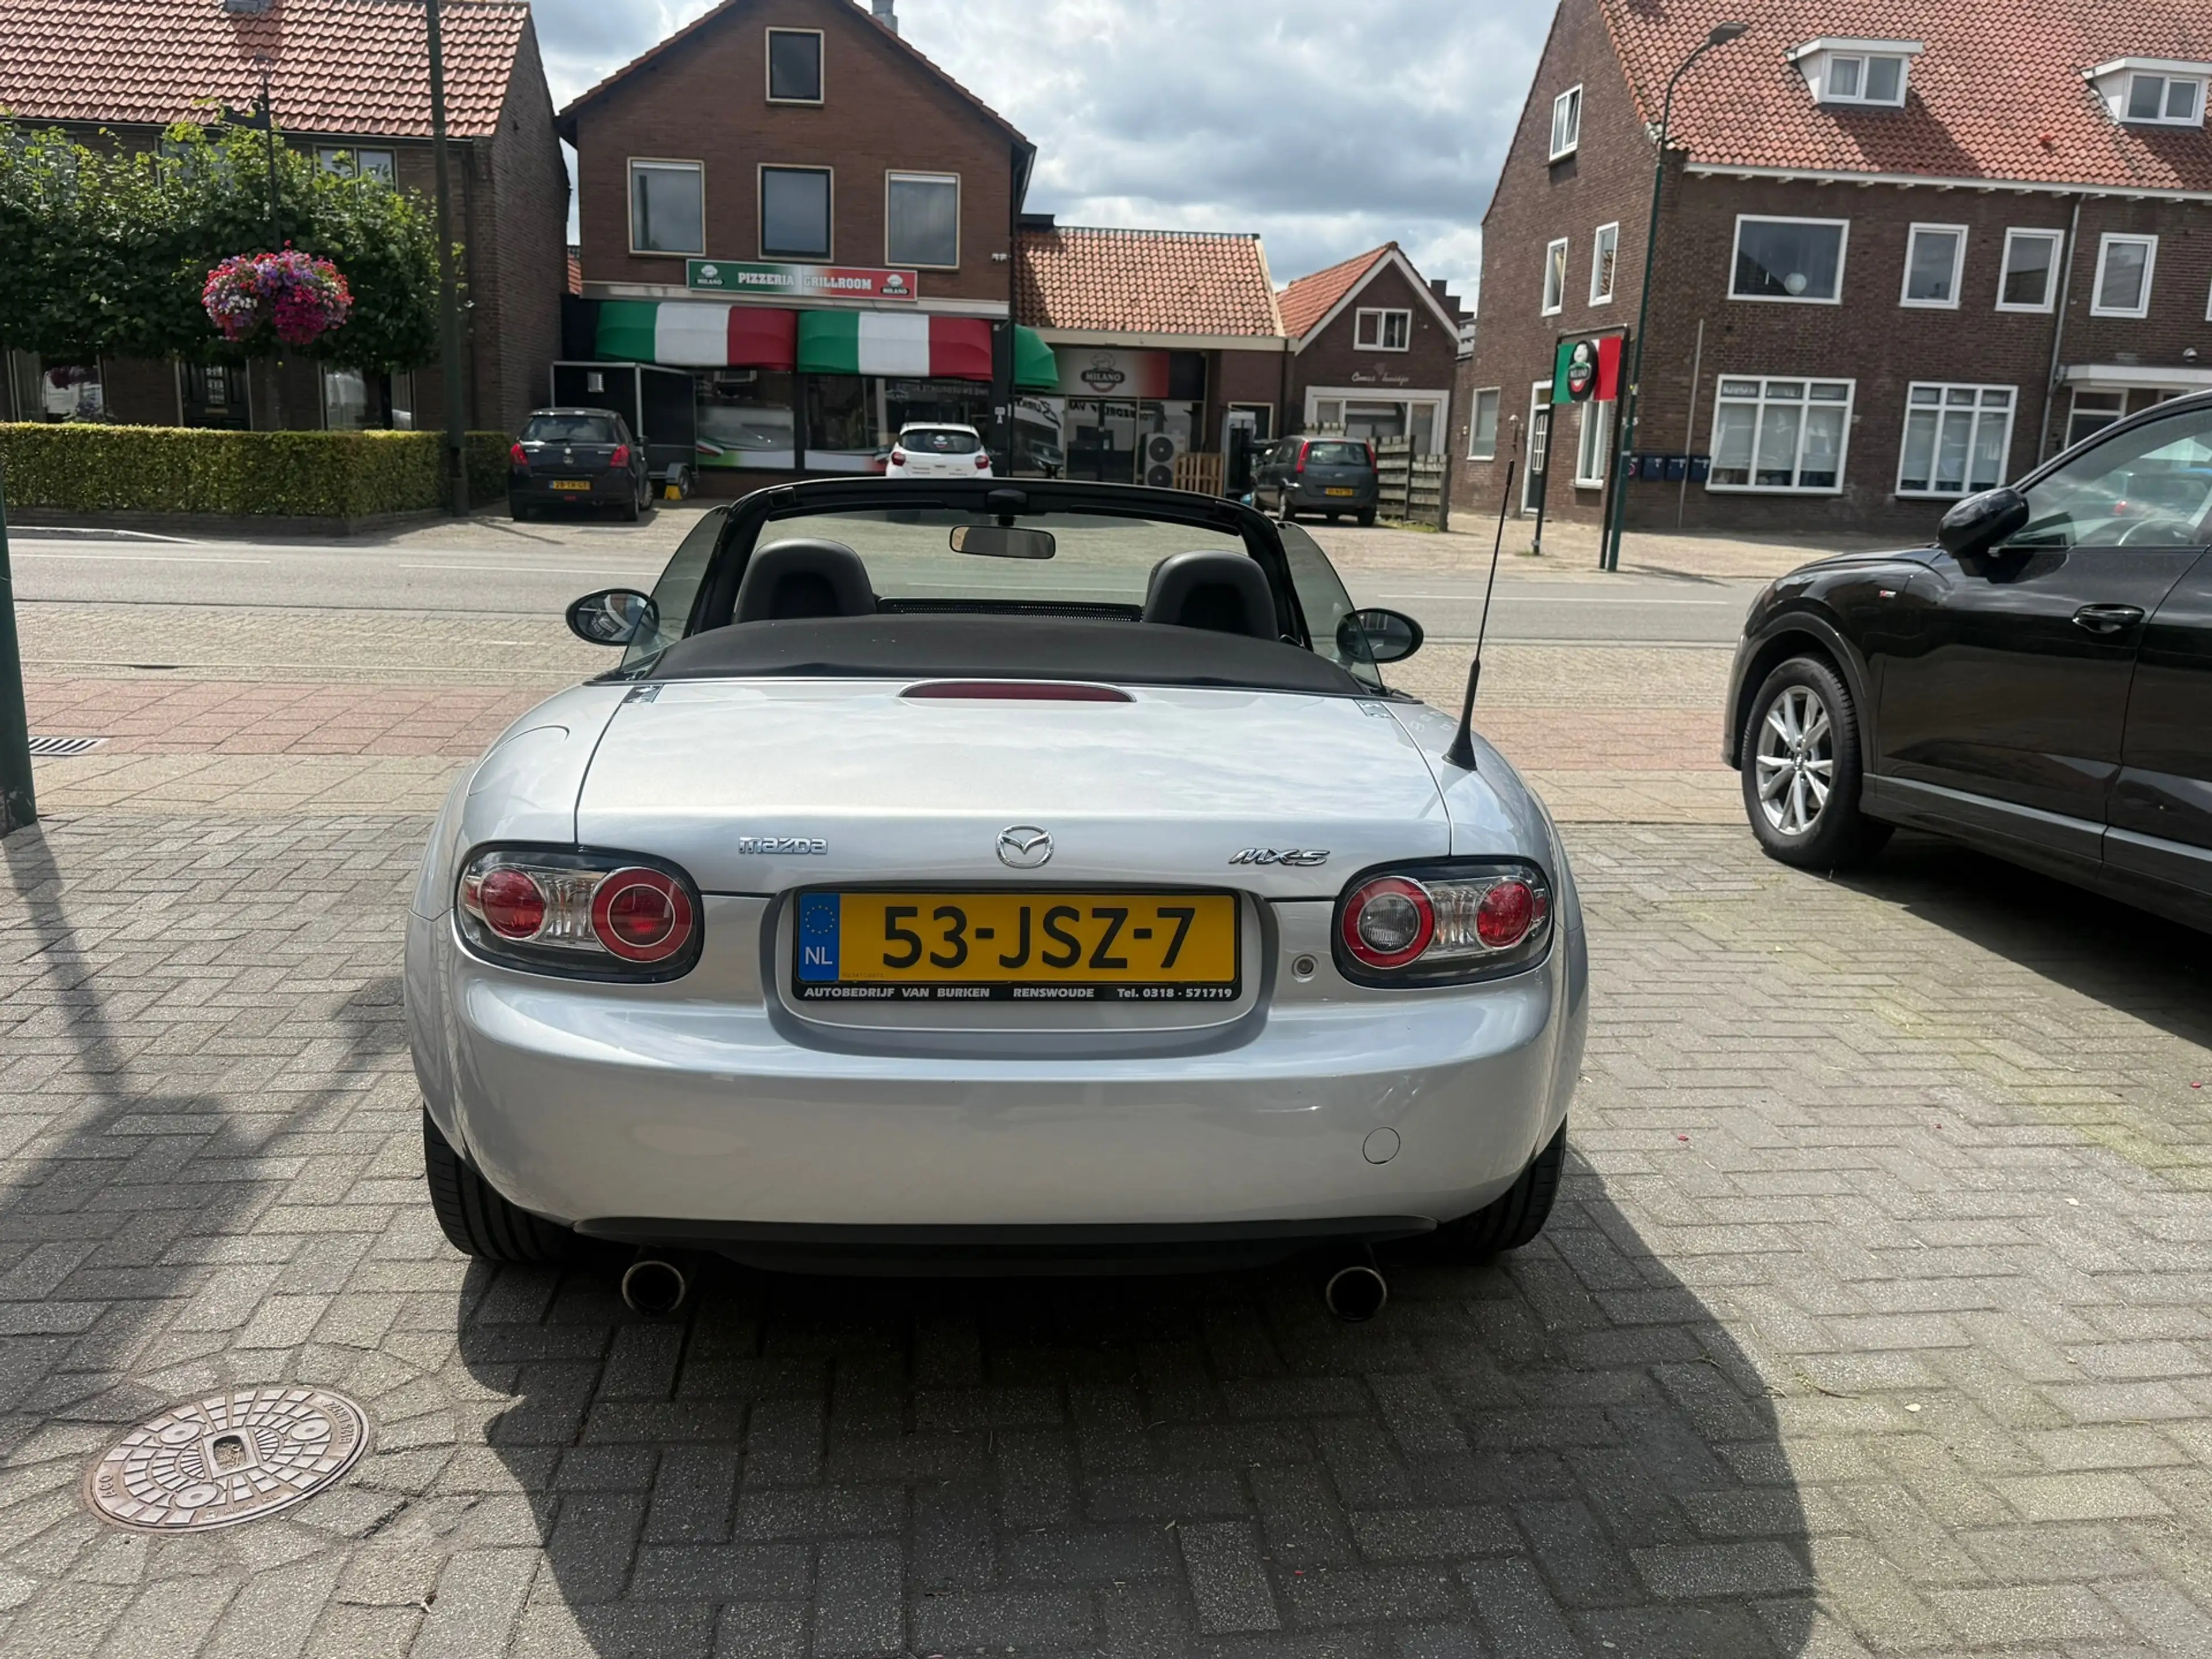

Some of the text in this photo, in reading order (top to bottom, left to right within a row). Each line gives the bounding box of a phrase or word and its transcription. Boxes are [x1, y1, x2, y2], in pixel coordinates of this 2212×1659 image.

[738, 272, 872, 290] PIZZERIA GRILLROOM
[1085, 372, 1122, 381] MILANO
[1228, 847, 1330, 866] MX-5
[883, 906, 1195, 969] 53-JSZ-7
[805, 946, 833, 965] NL
[804, 987, 895, 998] AUTOBEDRIJF
[902, 988, 929, 998] VAN
[937, 988, 990, 998] BURKEN
[1013, 988, 1094, 998] RENSWOUDE
[1118, 988, 1139, 998] Tel.
[1143, 988, 1174, 998] 0318
[1185, 988, 1232, 998] 571719
[99, 1475, 117, 1498] ACO
